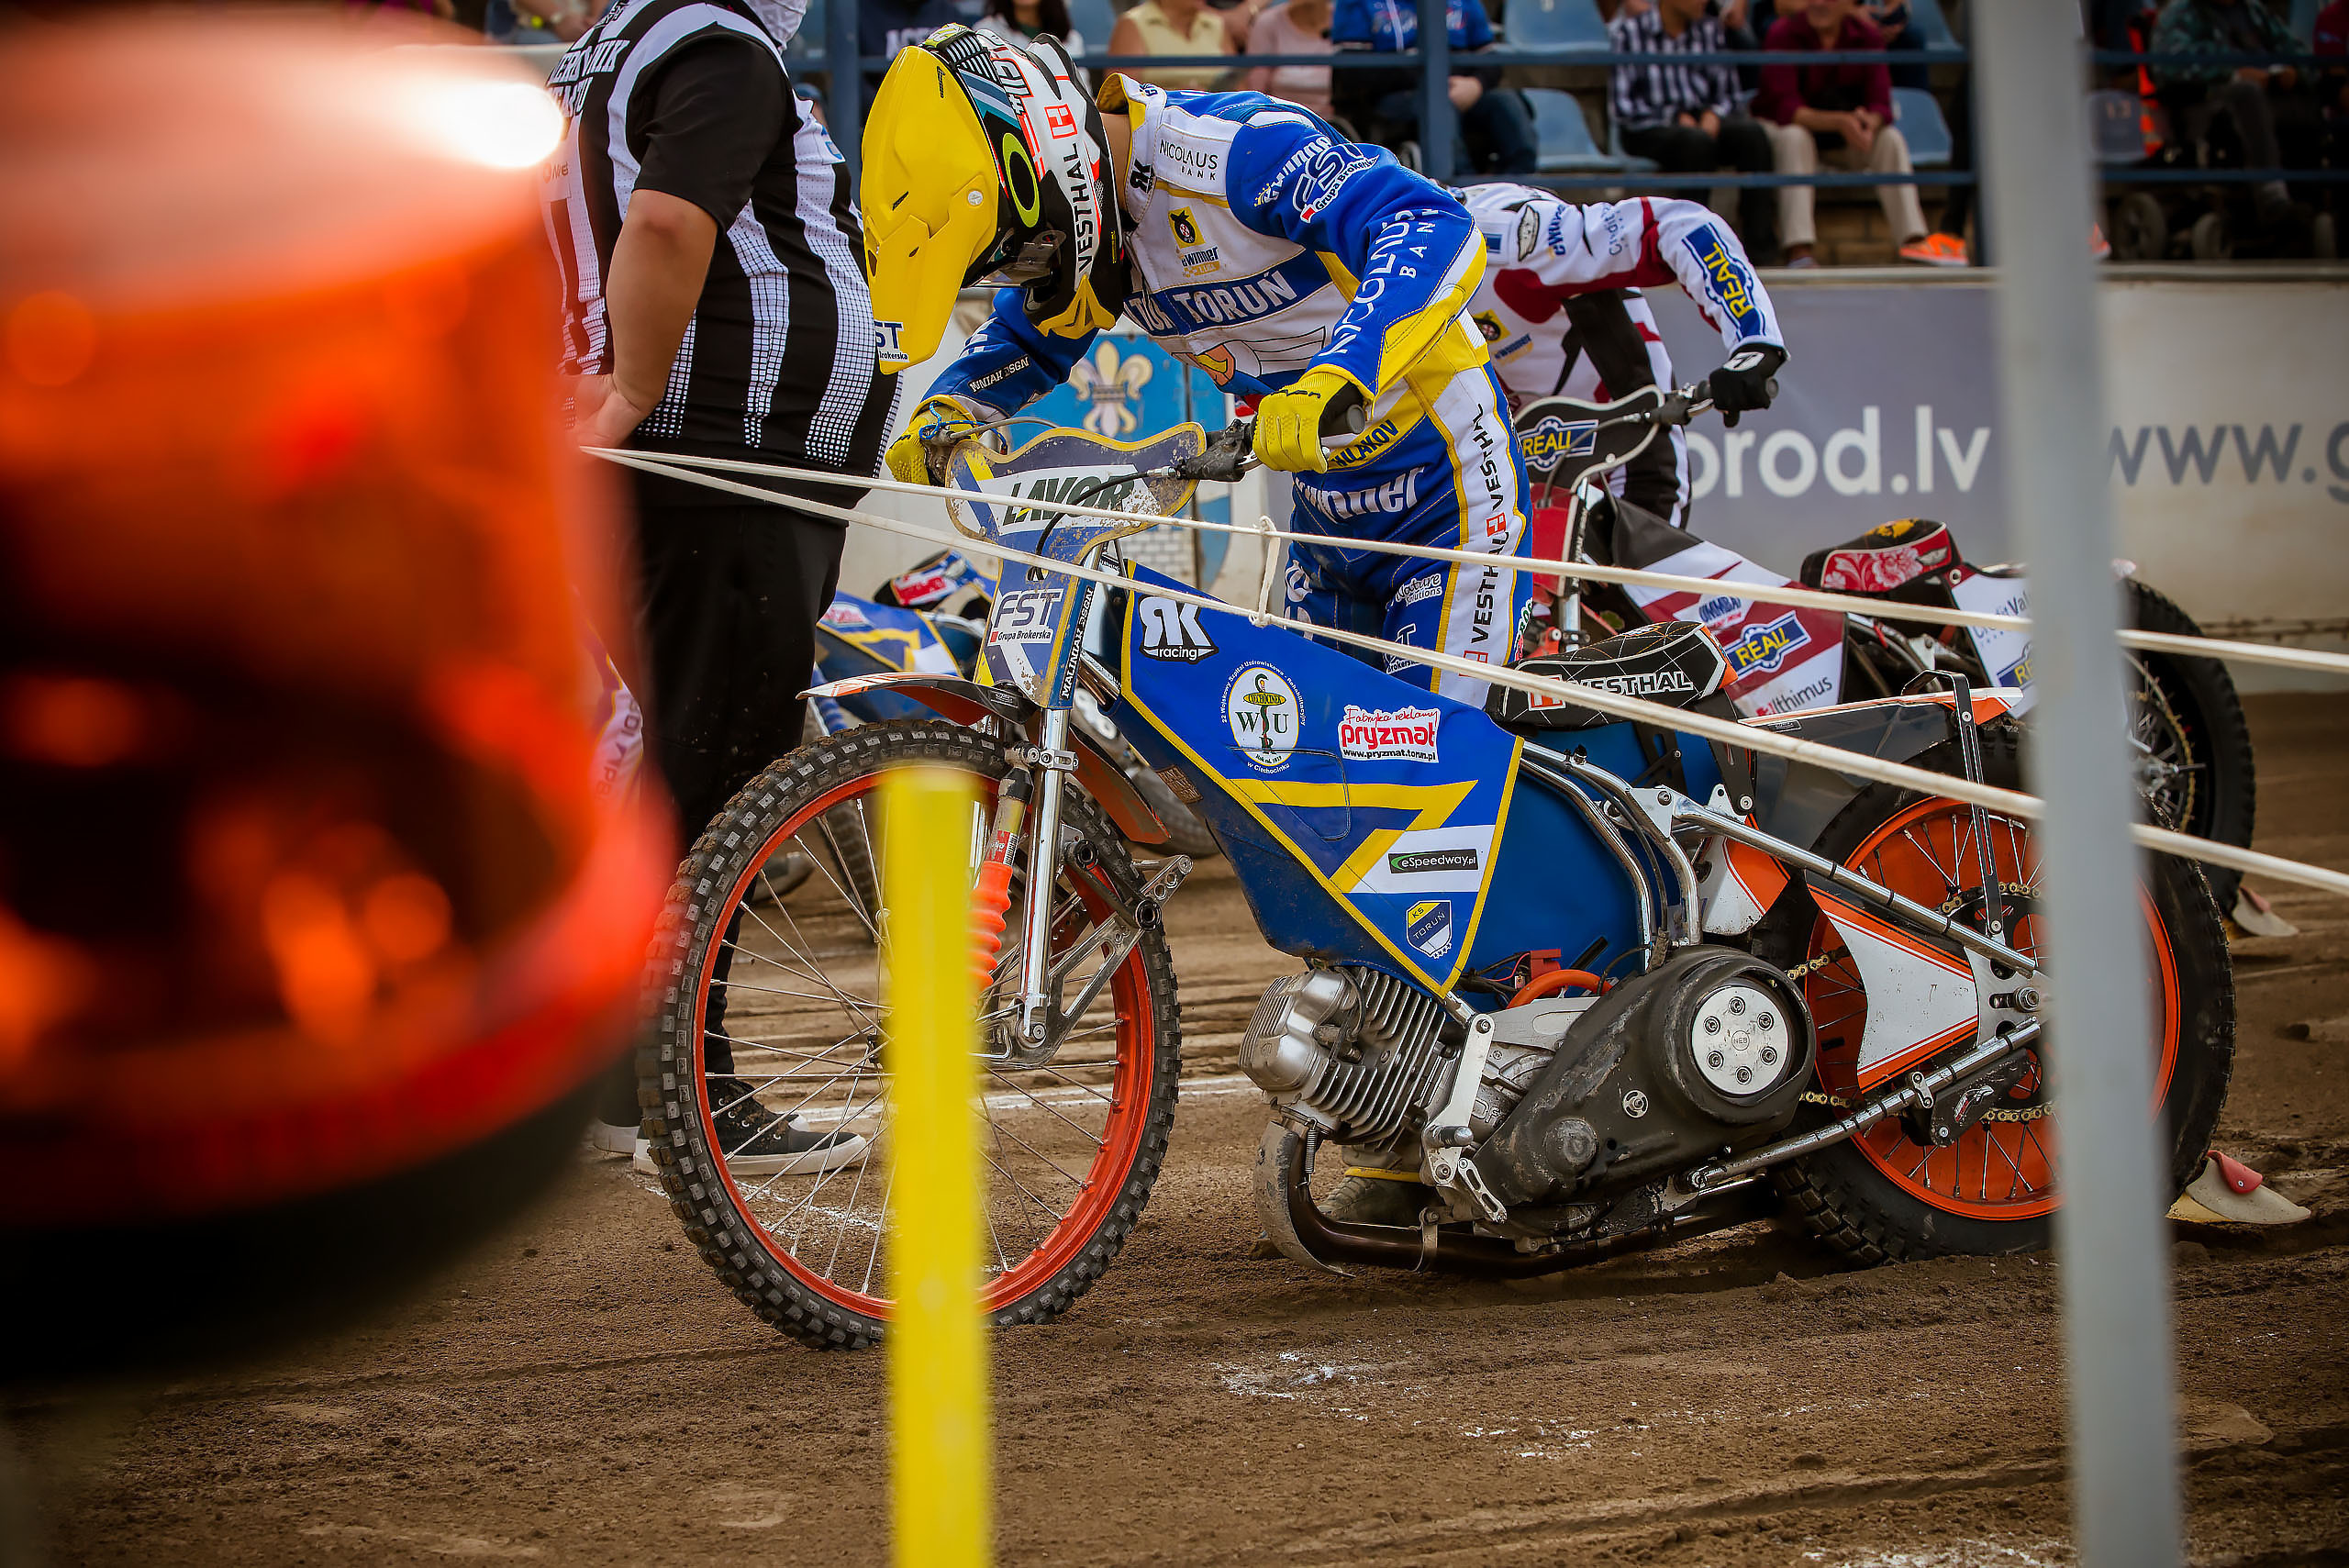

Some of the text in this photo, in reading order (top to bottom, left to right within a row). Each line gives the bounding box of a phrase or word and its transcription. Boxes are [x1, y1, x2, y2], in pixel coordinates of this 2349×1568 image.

[1159, 139, 1219, 170] NICOLAUS
[1181, 165, 1217, 181] BANK
[1063, 142, 1093, 272] VESTHAL
[1315, 182, 1341, 210] Grupa
[1173, 270, 1297, 324] TORUŃ
[1002, 474, 1136, 527] LAVOR
[1397, 573, 1442, 602] Nature
[994, 590, 1063, 628] FST
[997, 628, 1052, 641] Grupa Brokerska
[1735, 627, 1790, 667] REALL
[1159, 646, 1197, 661] racing
[1346, 707, 1438, 728] Fabryka reklamy
[1341, 722, 1435, 750] pryzmat
[1342, 749, 1436, 761] www.pryzmat.torun.pl
[1401, 854, 1476, 868] eSpeedway.pl
[1411, 906, 1425, 918] KS
[1412, 911, 1446, 940] TORUŃ
